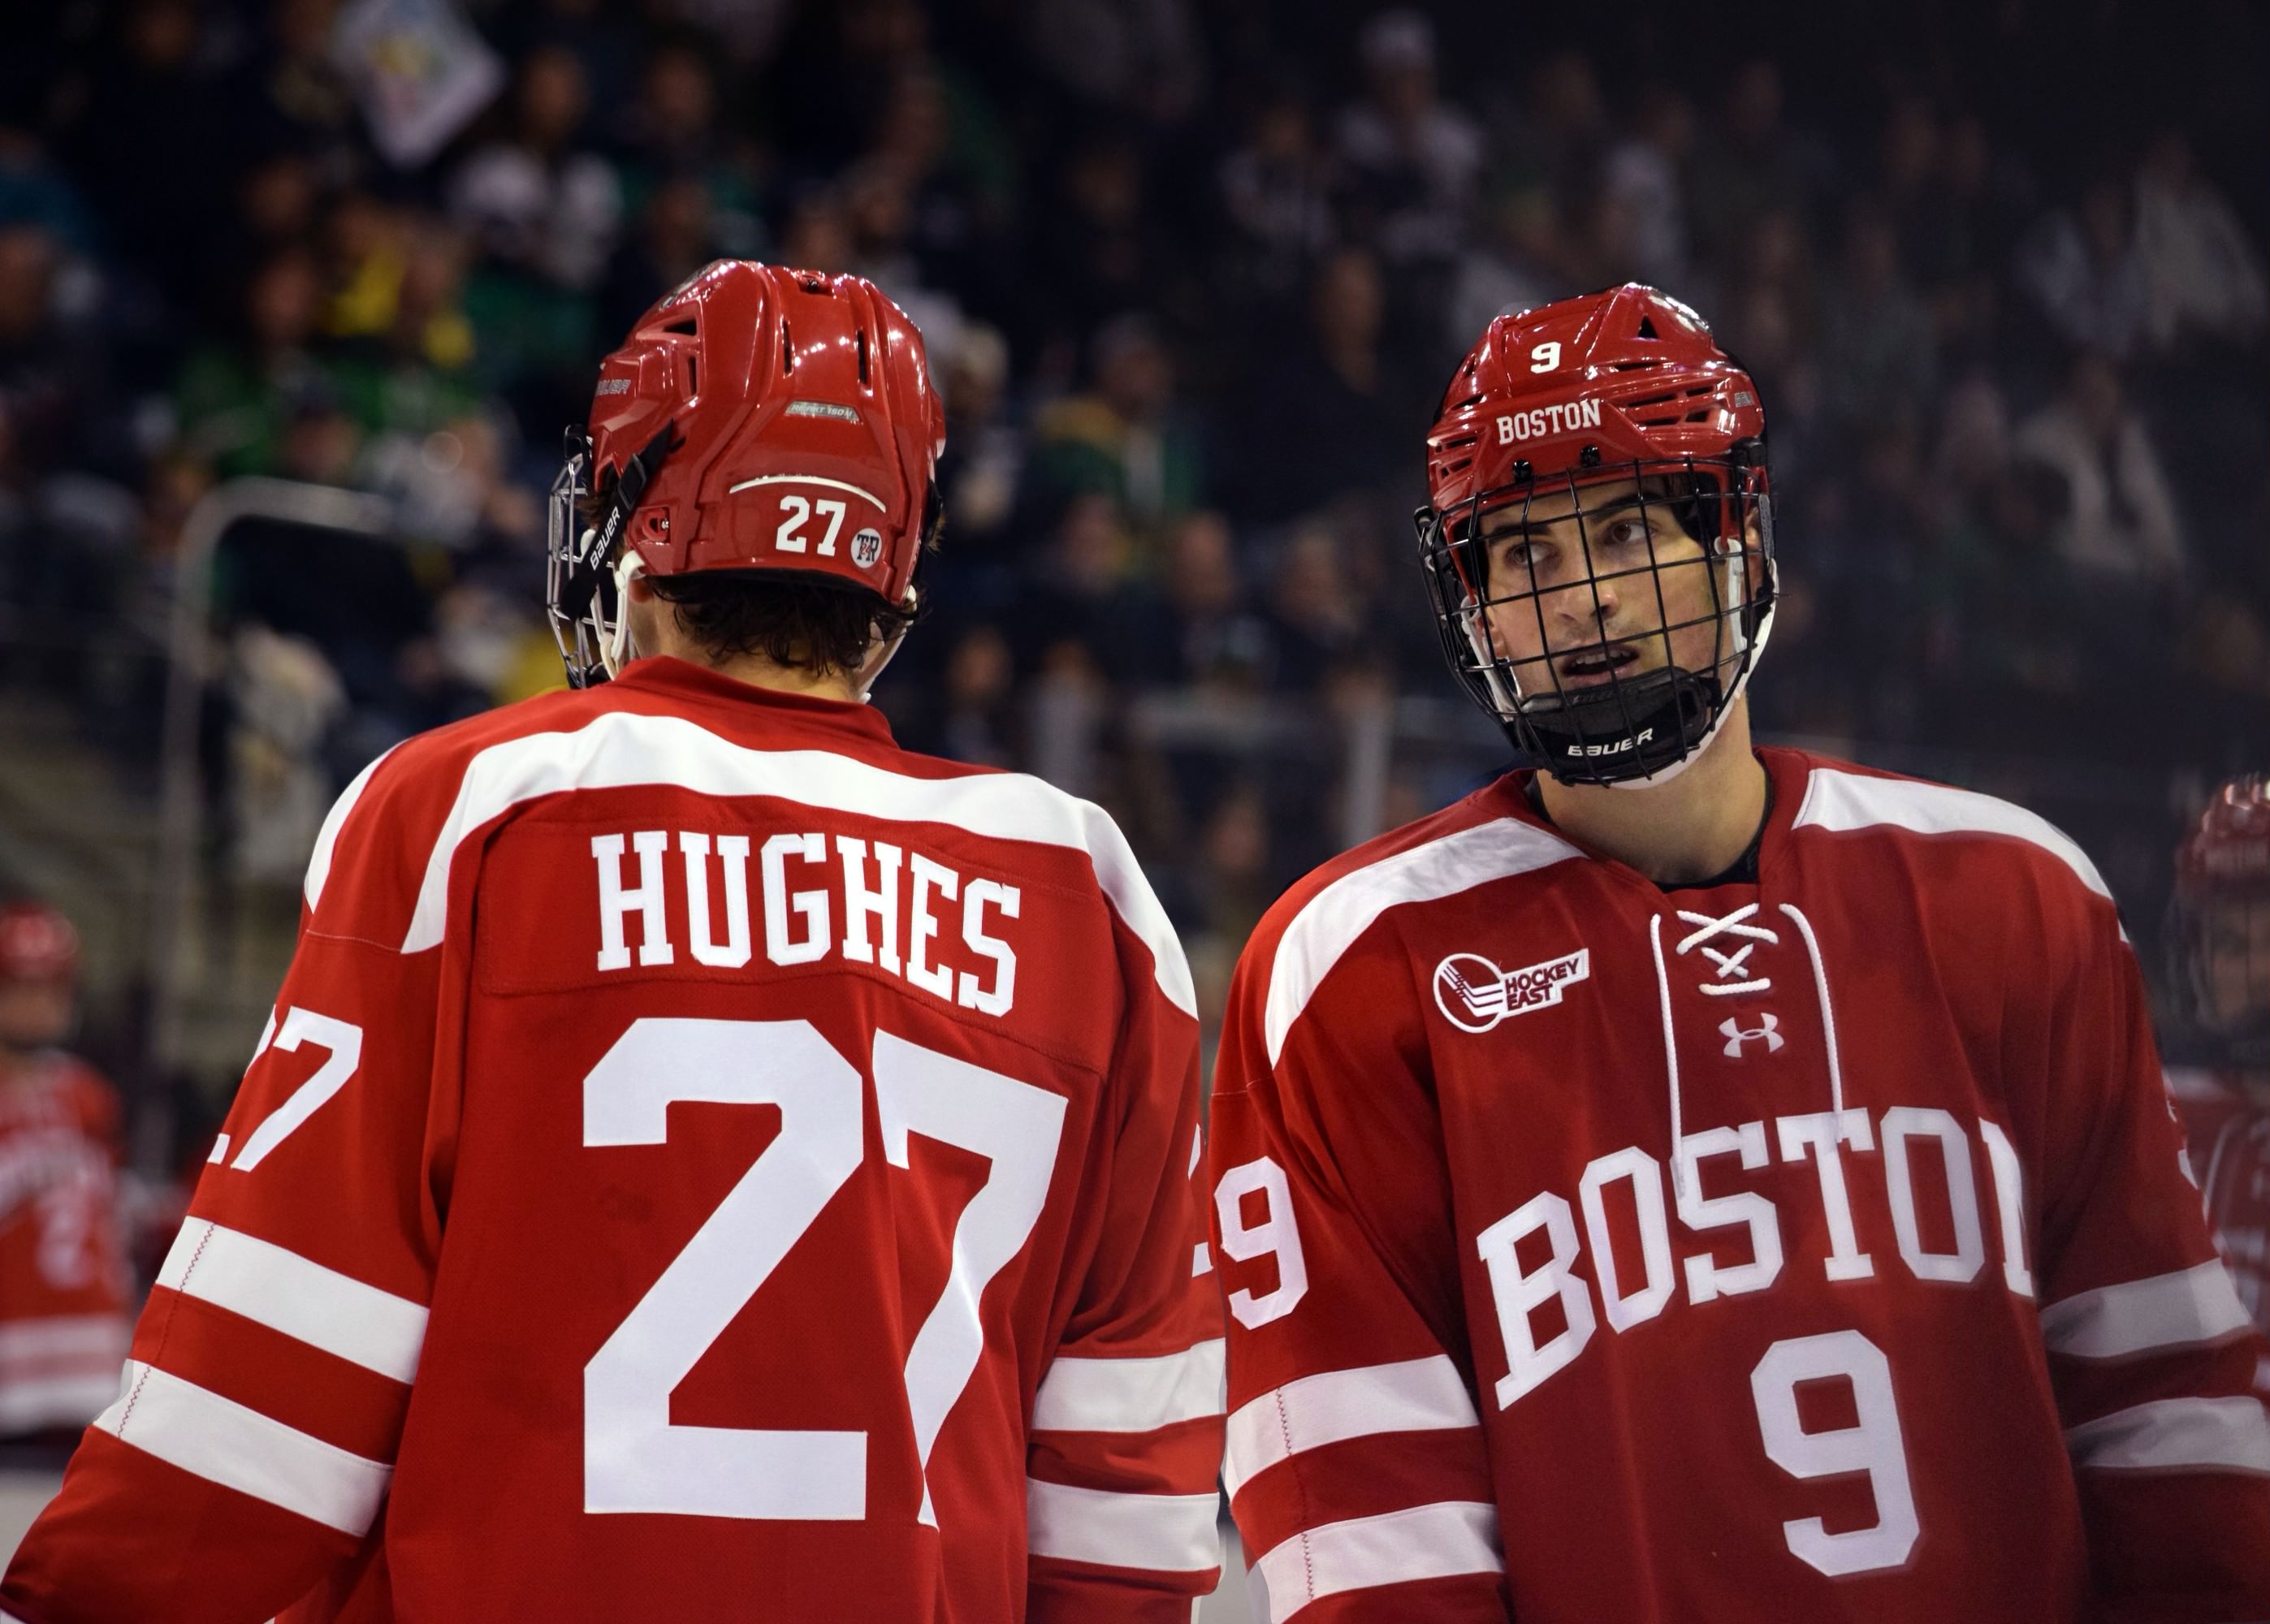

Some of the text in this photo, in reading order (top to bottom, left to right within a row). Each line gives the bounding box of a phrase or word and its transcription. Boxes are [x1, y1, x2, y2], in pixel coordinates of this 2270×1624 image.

[1531, 342, 1561, 374] 9
[1496, 398, 1601, 445] BOSTON
[776, 495, 845, 556] 27
[591, 830, 1021, 1018] HUGHES
[1504, 957, 1579, 995] HOCKEY
[1506, 983, 1553, 1012] EAST
[207, 1004, 363, 1172] 7
[583, 1017, 1069, 1532] 27
[1214, 1155, 1308, 1331] 9
[1750, 1329, 1920, 1577] 9
